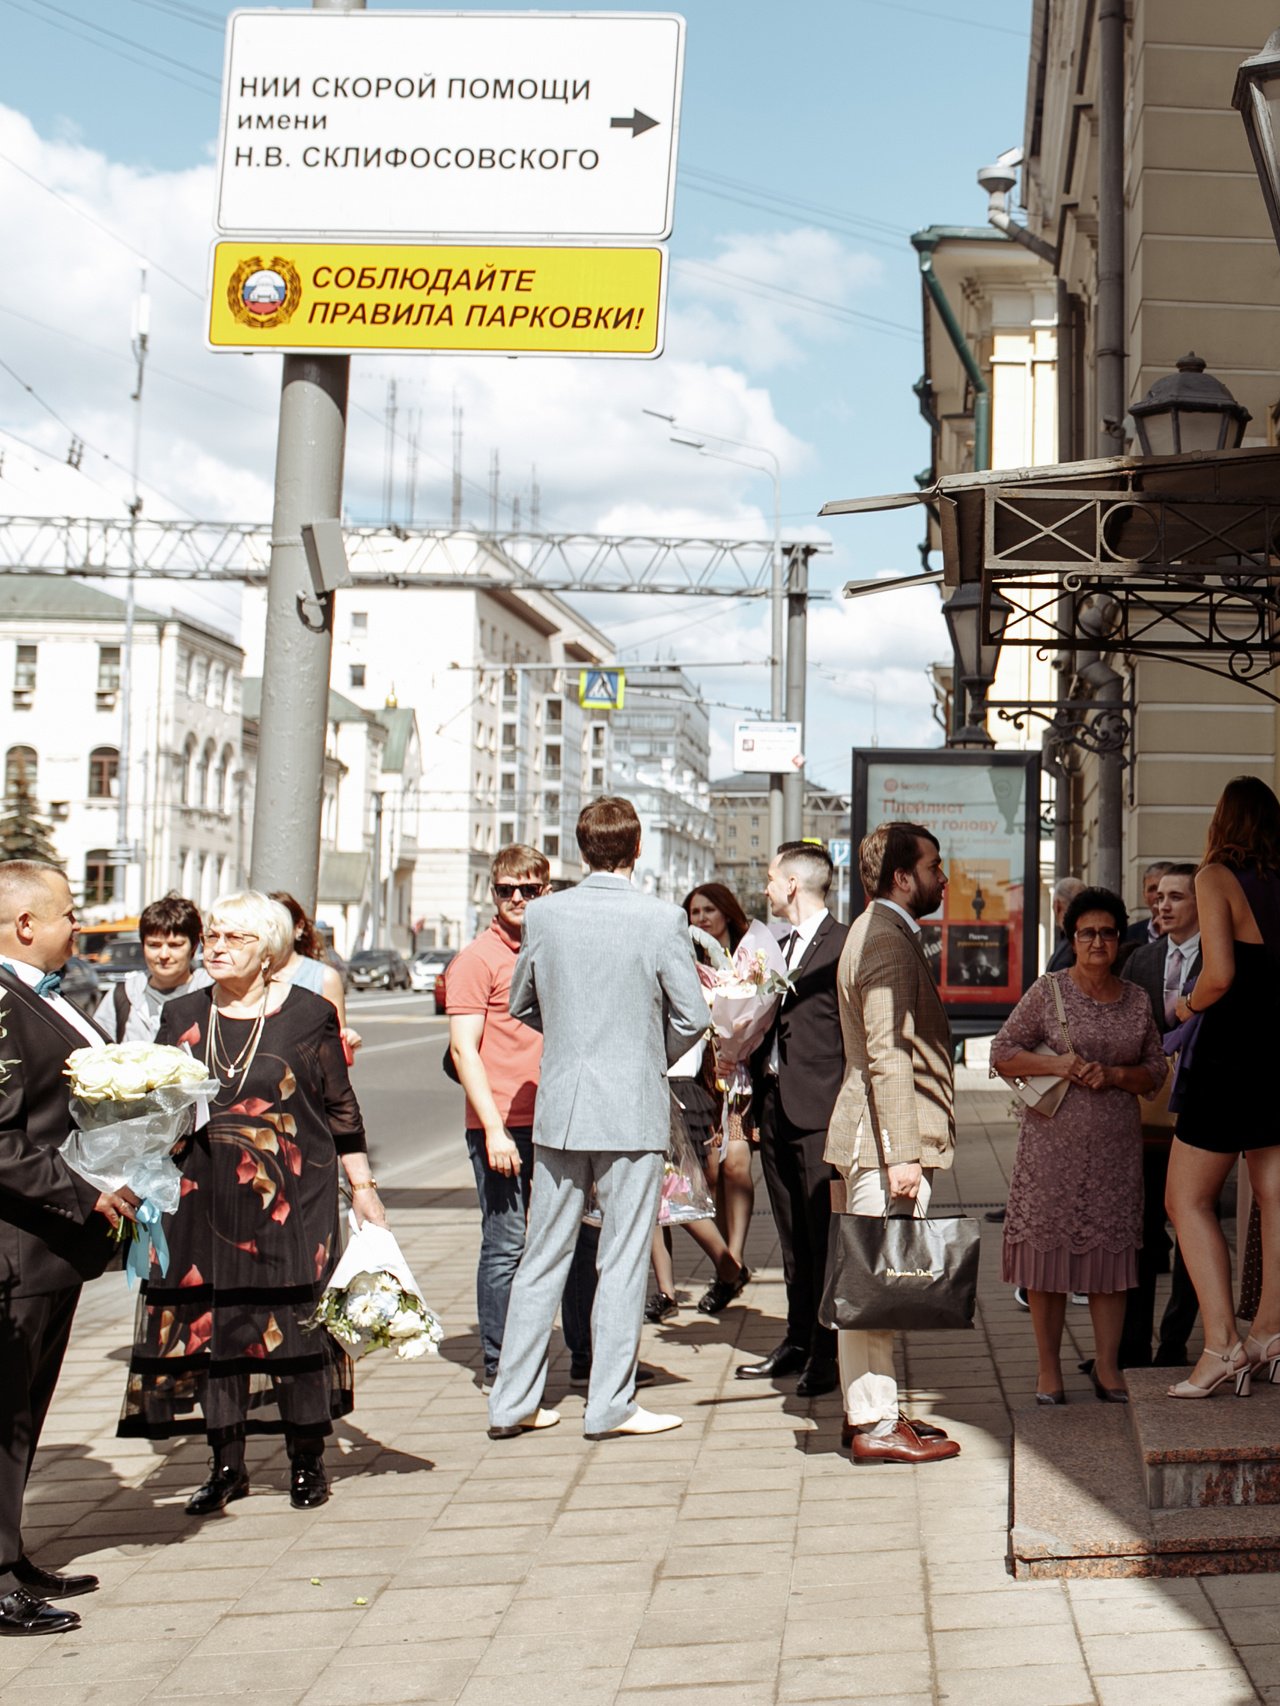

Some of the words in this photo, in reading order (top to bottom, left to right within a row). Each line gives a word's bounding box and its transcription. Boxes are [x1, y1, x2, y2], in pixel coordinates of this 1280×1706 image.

[240, 76, 301, 98] НИИ
[312, 73, 436, 98] СКОРОЙ
[447, 78, 590, 104] ПОМОЩИ
[237, 114, 327, 130] имени
[235, 146, 291, 168] Н.В.
[302, 147, 599, 171] СКЛИФОСОВСКОГО
[312, 264, 536, 297] СОБЛЮДАЙТЕ
[307, 302, 454, 327] ПРАВИЛА
[464, 305, 646, 330] ПАРКОВКИ!
[883, 799, 965, 814] Плейлист
[942, 819, 999, 835] голову
